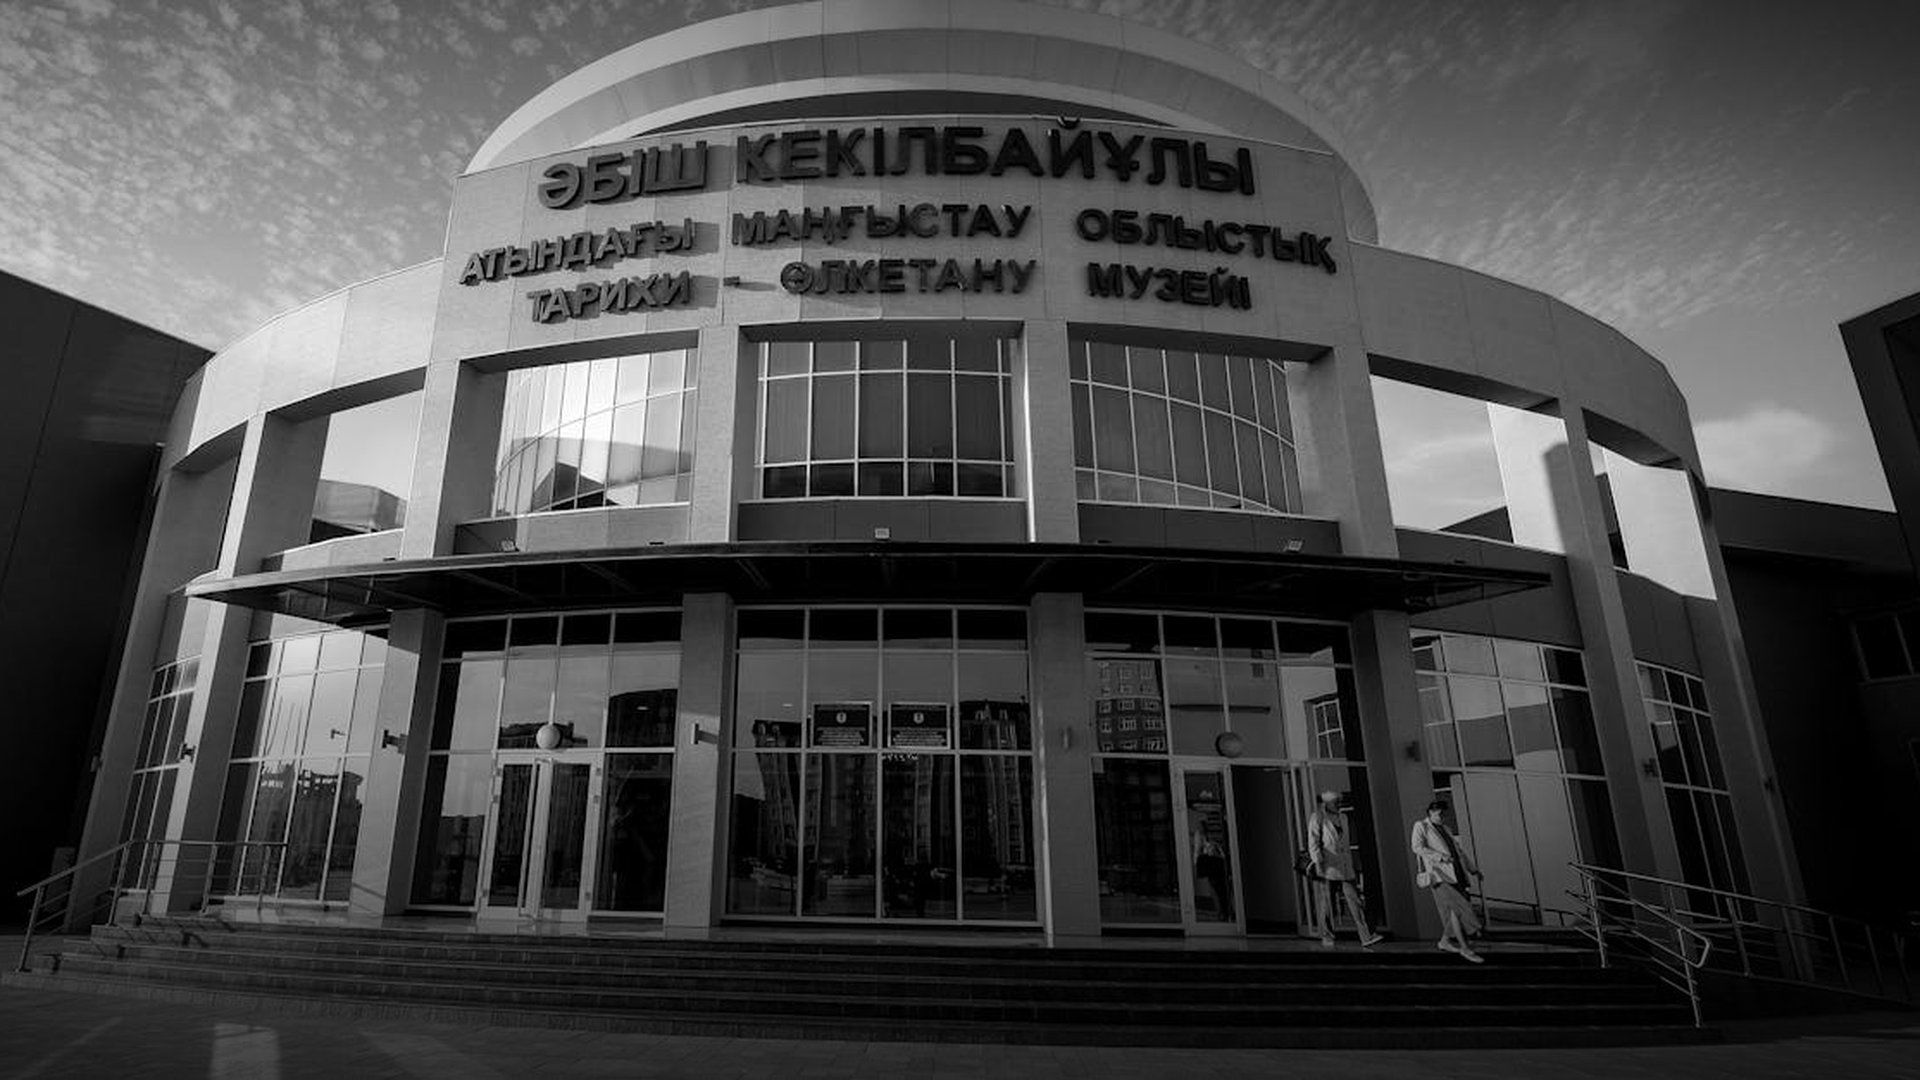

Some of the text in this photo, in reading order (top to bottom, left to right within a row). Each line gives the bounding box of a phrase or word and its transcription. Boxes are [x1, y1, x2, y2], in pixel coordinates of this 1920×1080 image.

[541, 116, 1255, 208] ӘБІШ КЕКІЛБАЙҰЛЫ
[460, 203, 1336, 285] АТЫНДАҒЫ МАҢҒЫСТАУ ОБЛЫСТЫҚ
[527, 271, 690, 323] ТАРИХИ
[780, 259, 1036, 295] ӨЛКЕТАНУ
[1088, 262, 1251, 309] МУЗЕЙІ
